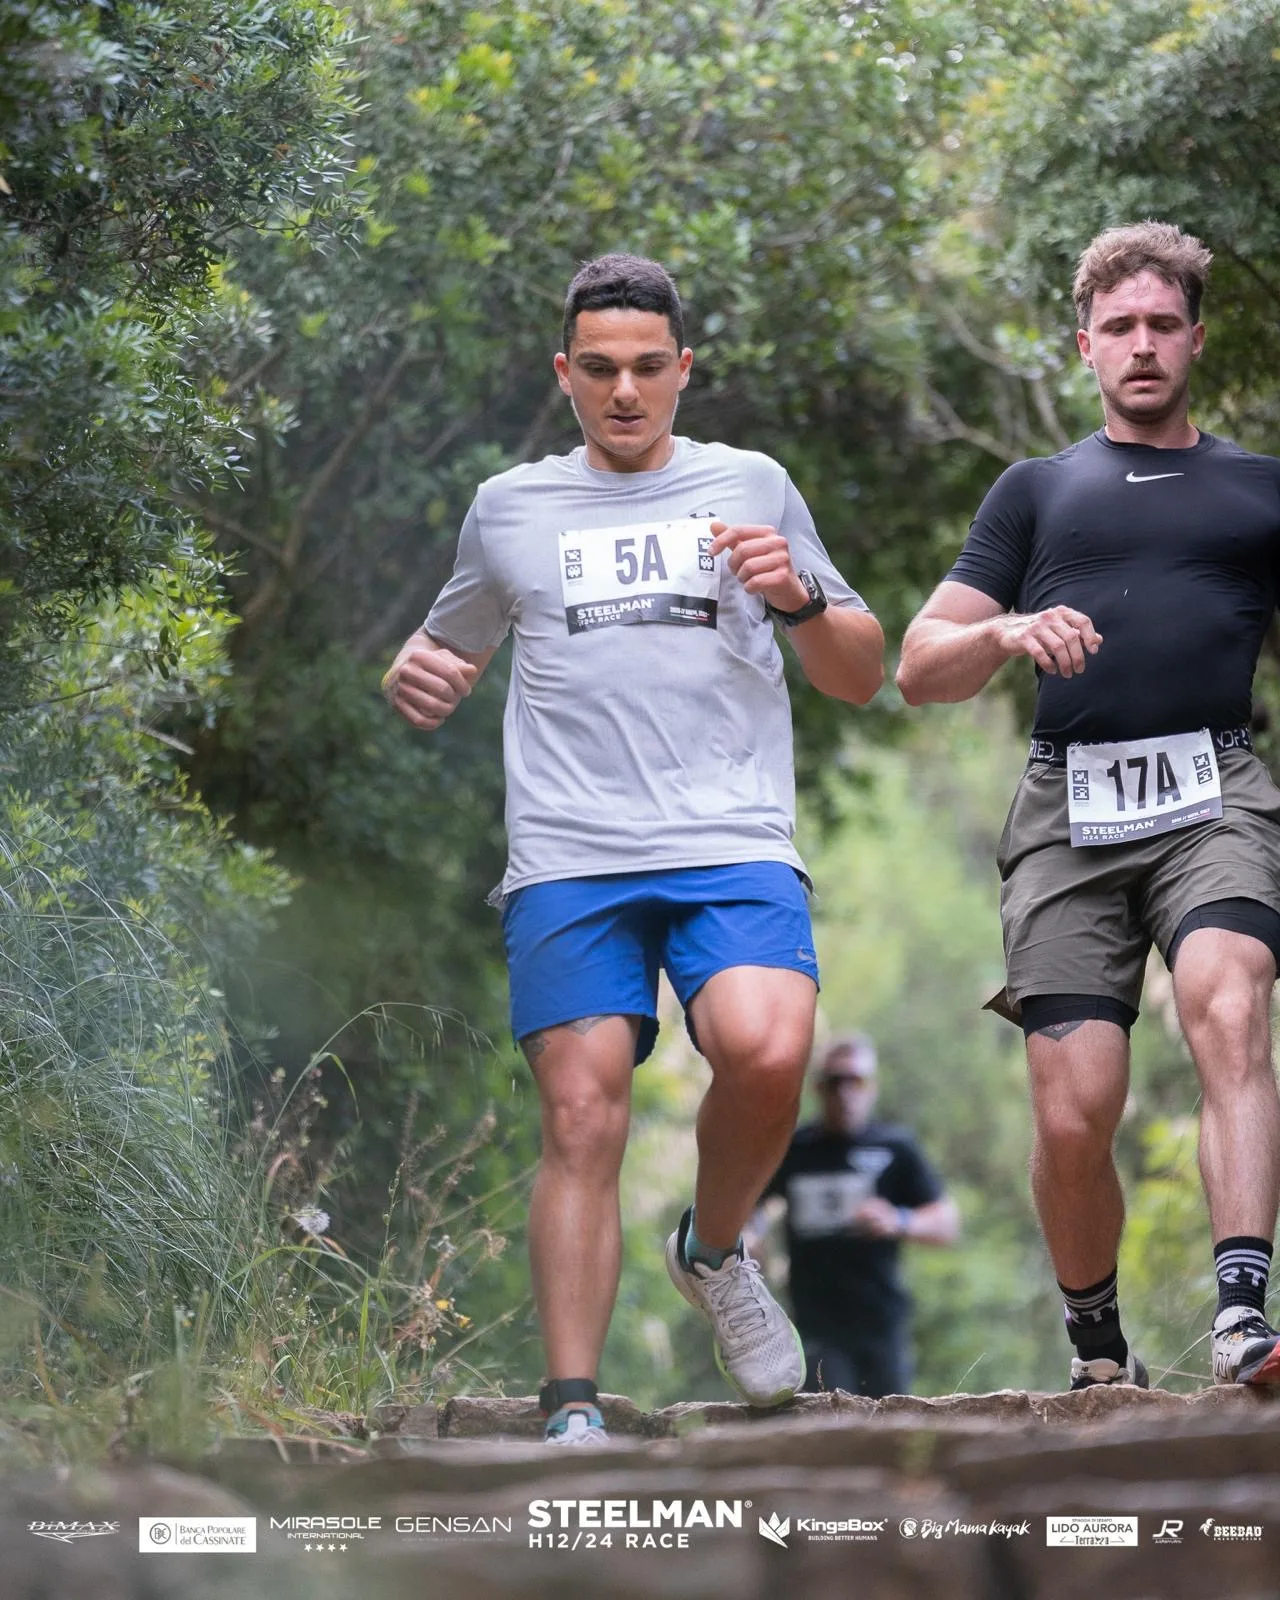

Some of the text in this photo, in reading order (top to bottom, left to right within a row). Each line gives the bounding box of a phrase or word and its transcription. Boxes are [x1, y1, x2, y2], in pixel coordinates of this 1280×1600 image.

[614, 533, 669, 586] 5A
[576, 597, 654, 620] STEELMAN
[597, 613, 622, 623] RACE
[1106, 751, 1182, 812] 17A
[1081, 819, 1155, 835] STEELMAN
[1082, 832, 1125, 841] H24 RACE
